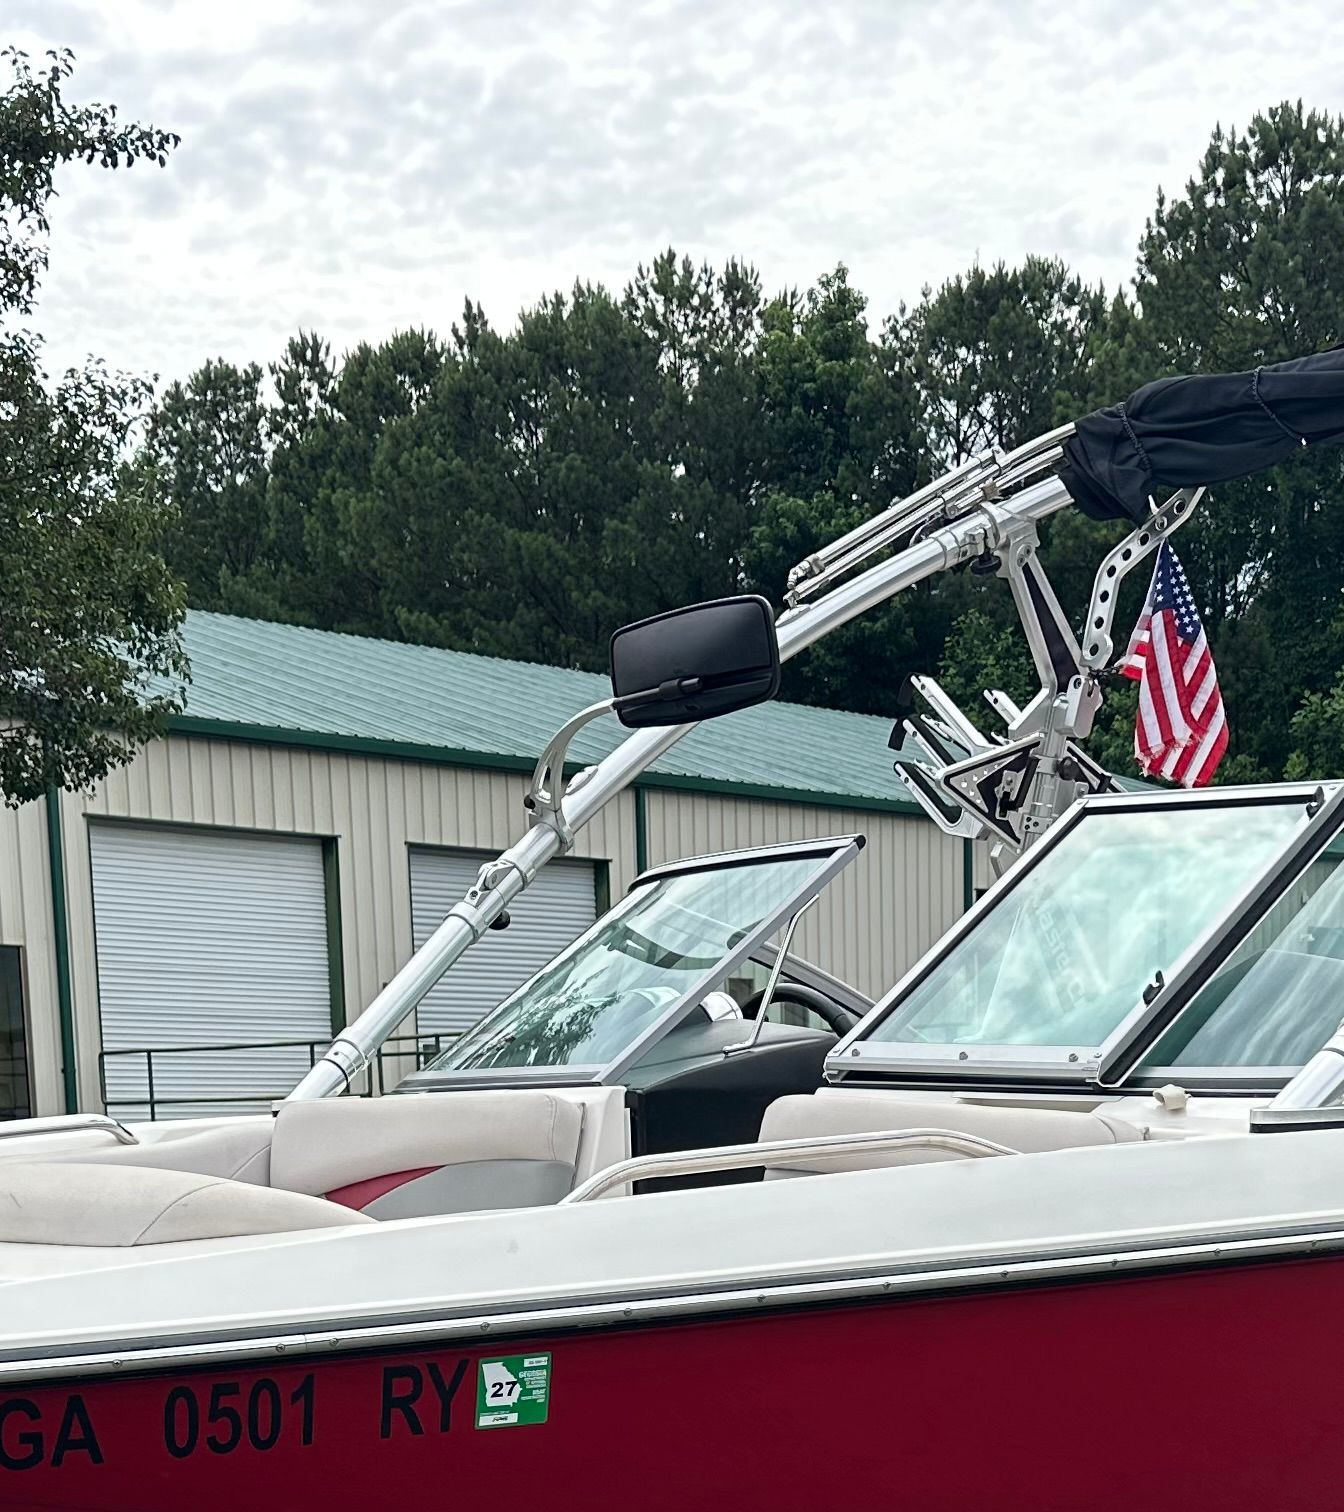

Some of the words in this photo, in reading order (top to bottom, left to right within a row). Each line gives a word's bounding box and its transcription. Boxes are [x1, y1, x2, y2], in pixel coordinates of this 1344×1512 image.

[163, 1373, 316, 1460] 0501
[379, 1358, 470, 1440] RY
[491, 1381, 518, 1398] 27
